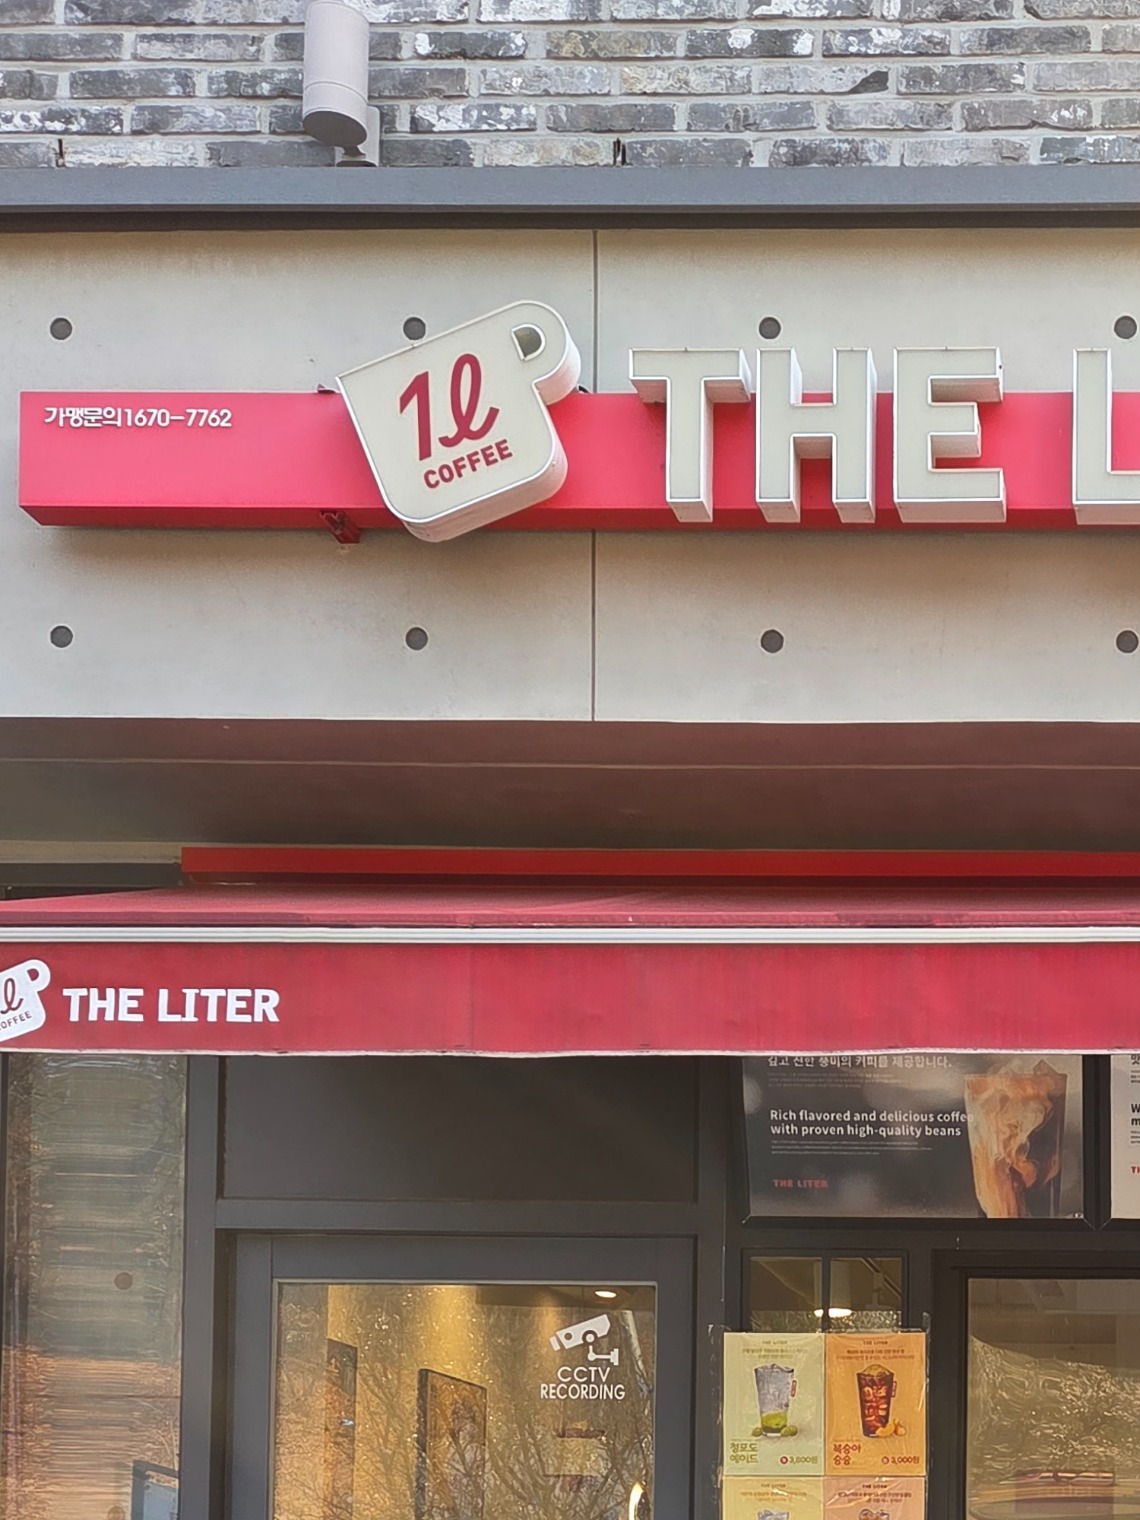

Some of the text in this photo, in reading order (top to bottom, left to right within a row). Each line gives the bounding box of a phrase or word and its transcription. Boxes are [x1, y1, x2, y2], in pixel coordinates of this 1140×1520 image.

[629, 346, 1006, 514] THE
[424, 439, 513, 489] COFFEE
[62, 987, 280, 1022] THE LITER
[0, 1010, 32, 1031] OFFEE
[770, 1109, 975, 1122] Rich flavored and delicious coffee
[771, 1123, 962, 1138] with proven high-quality beans
[773, 1179, 794, 1188] THE
[557, 1366, 611, 1383] CCTV
[540, 1384, 625, 1400] RECORDING
[833, 1443, 861, 1454] 복숭아
